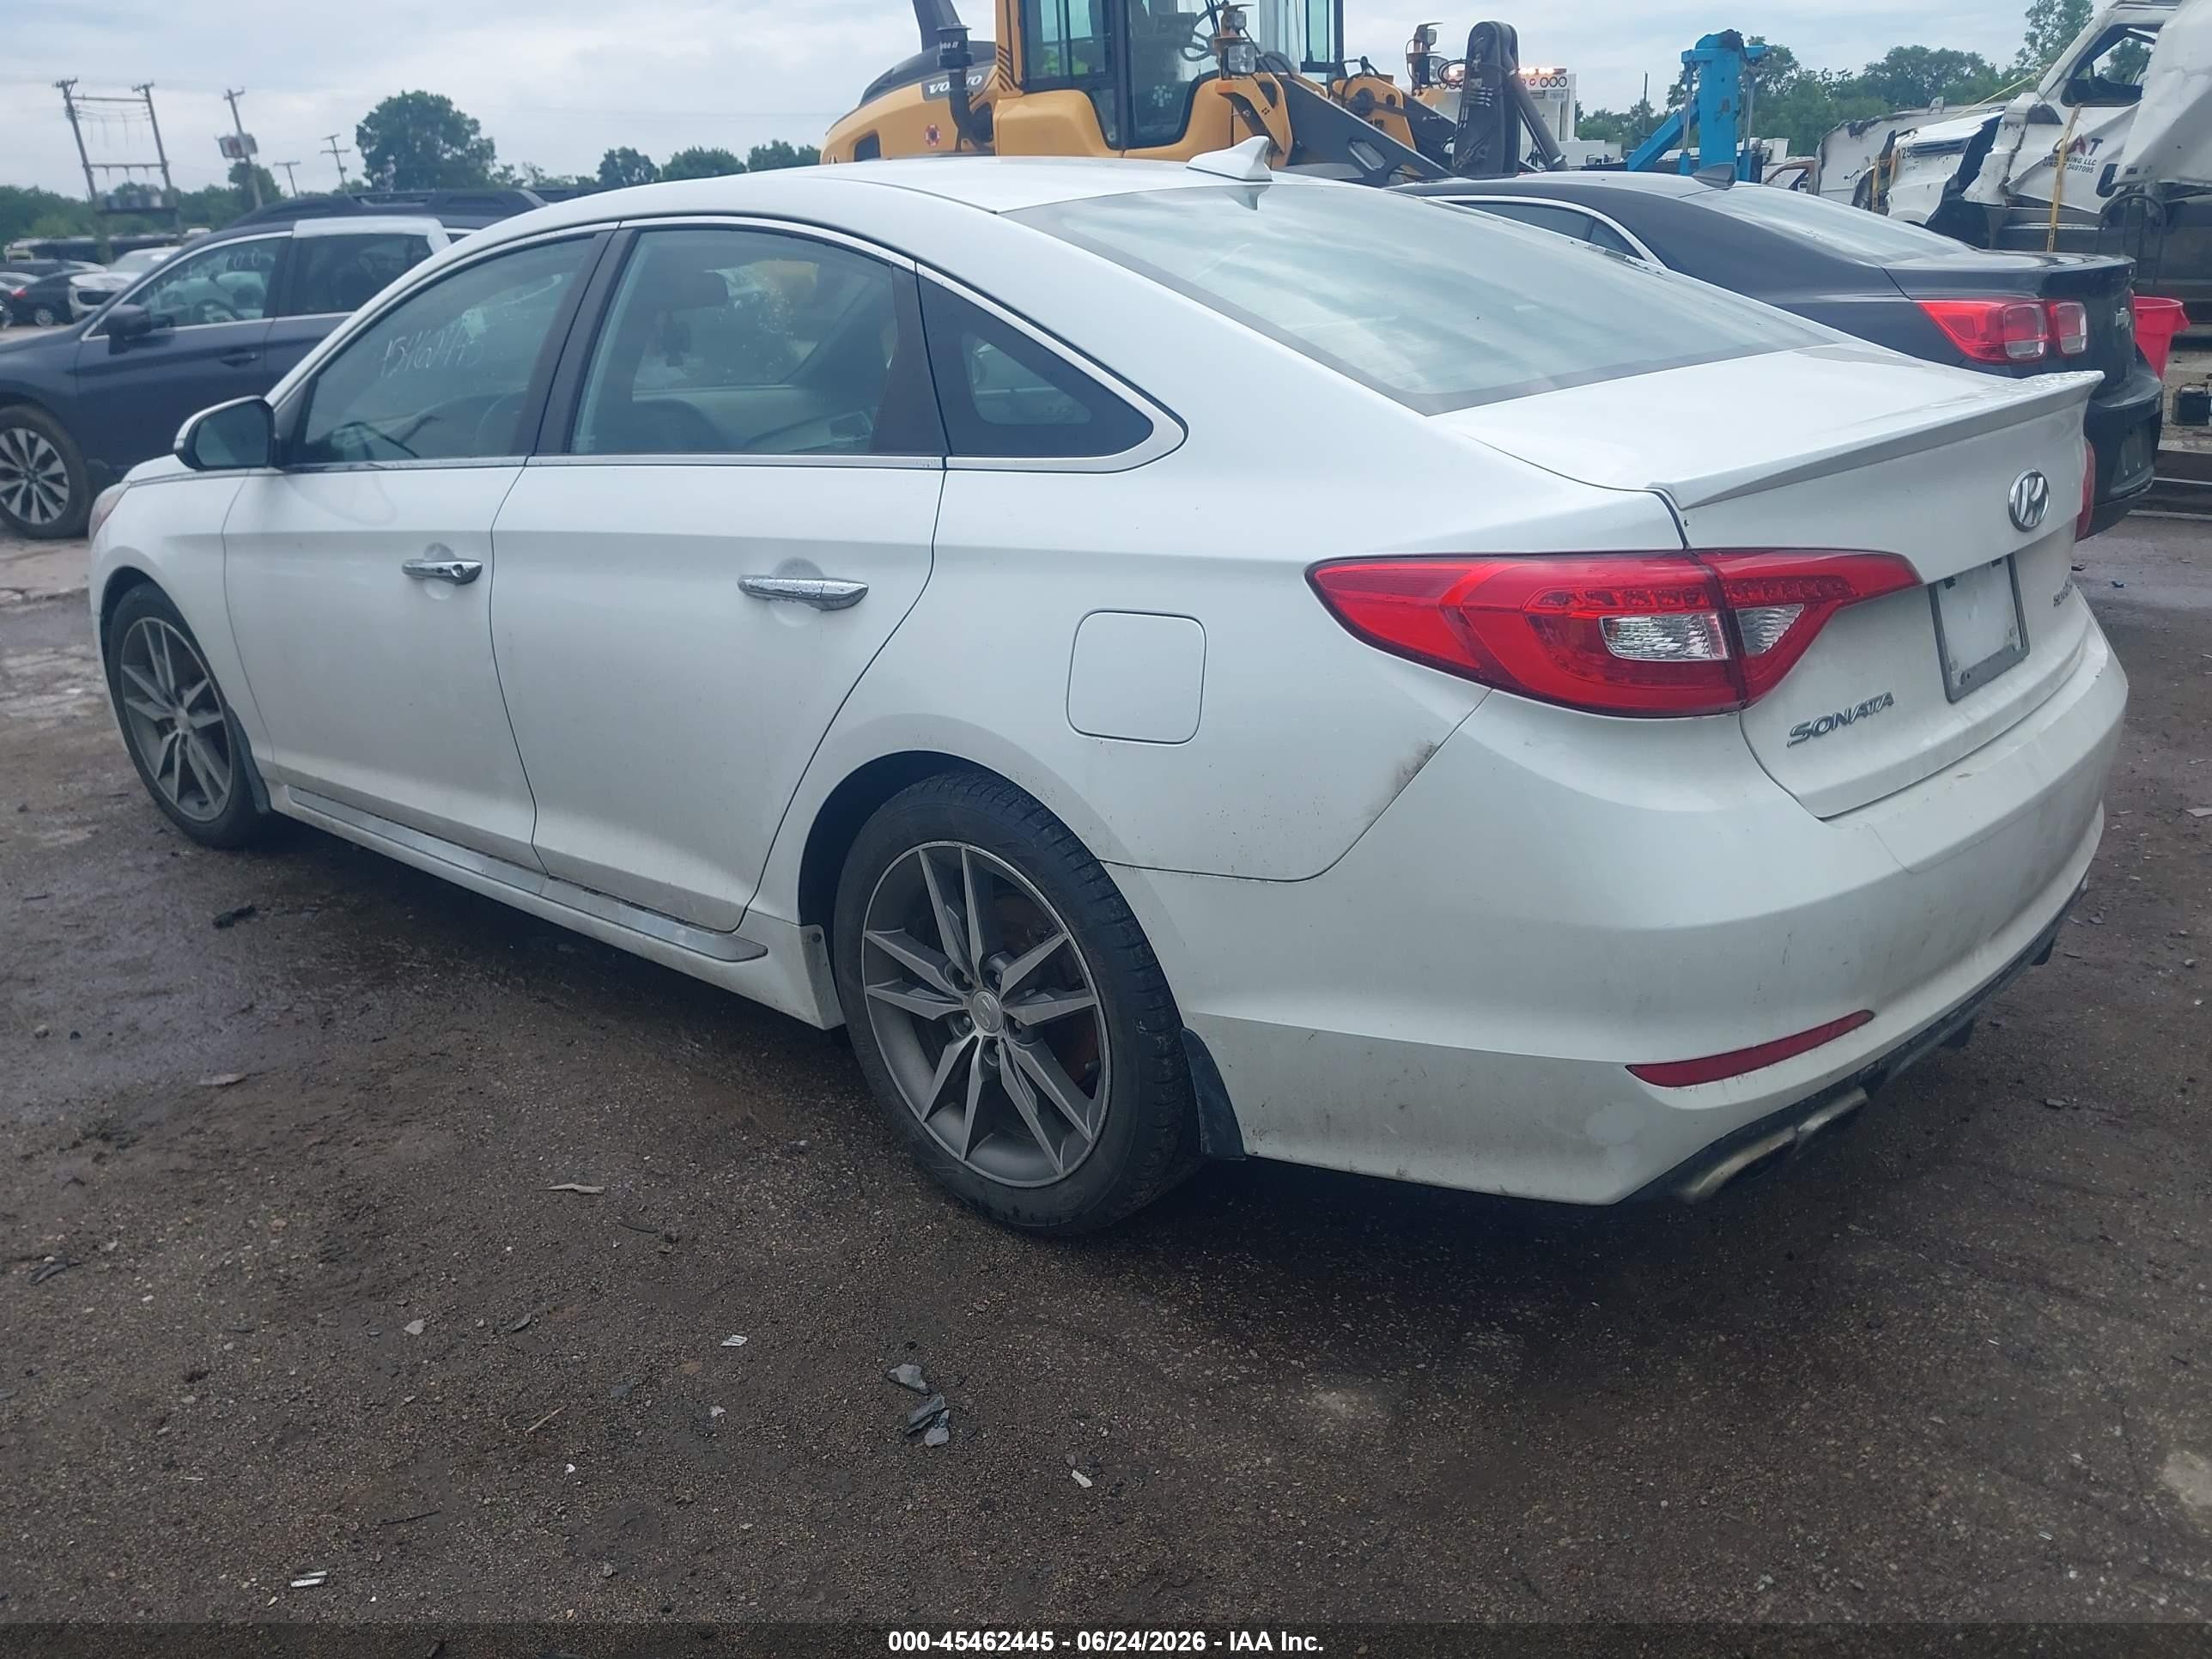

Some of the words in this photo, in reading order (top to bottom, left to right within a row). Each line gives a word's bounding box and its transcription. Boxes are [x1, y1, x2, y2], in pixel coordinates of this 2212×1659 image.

[928, 75, 982, 94] VOVO
[2083, 158, 2097, 167] LLC
[1786, 691, 1895, 748] SONATA
